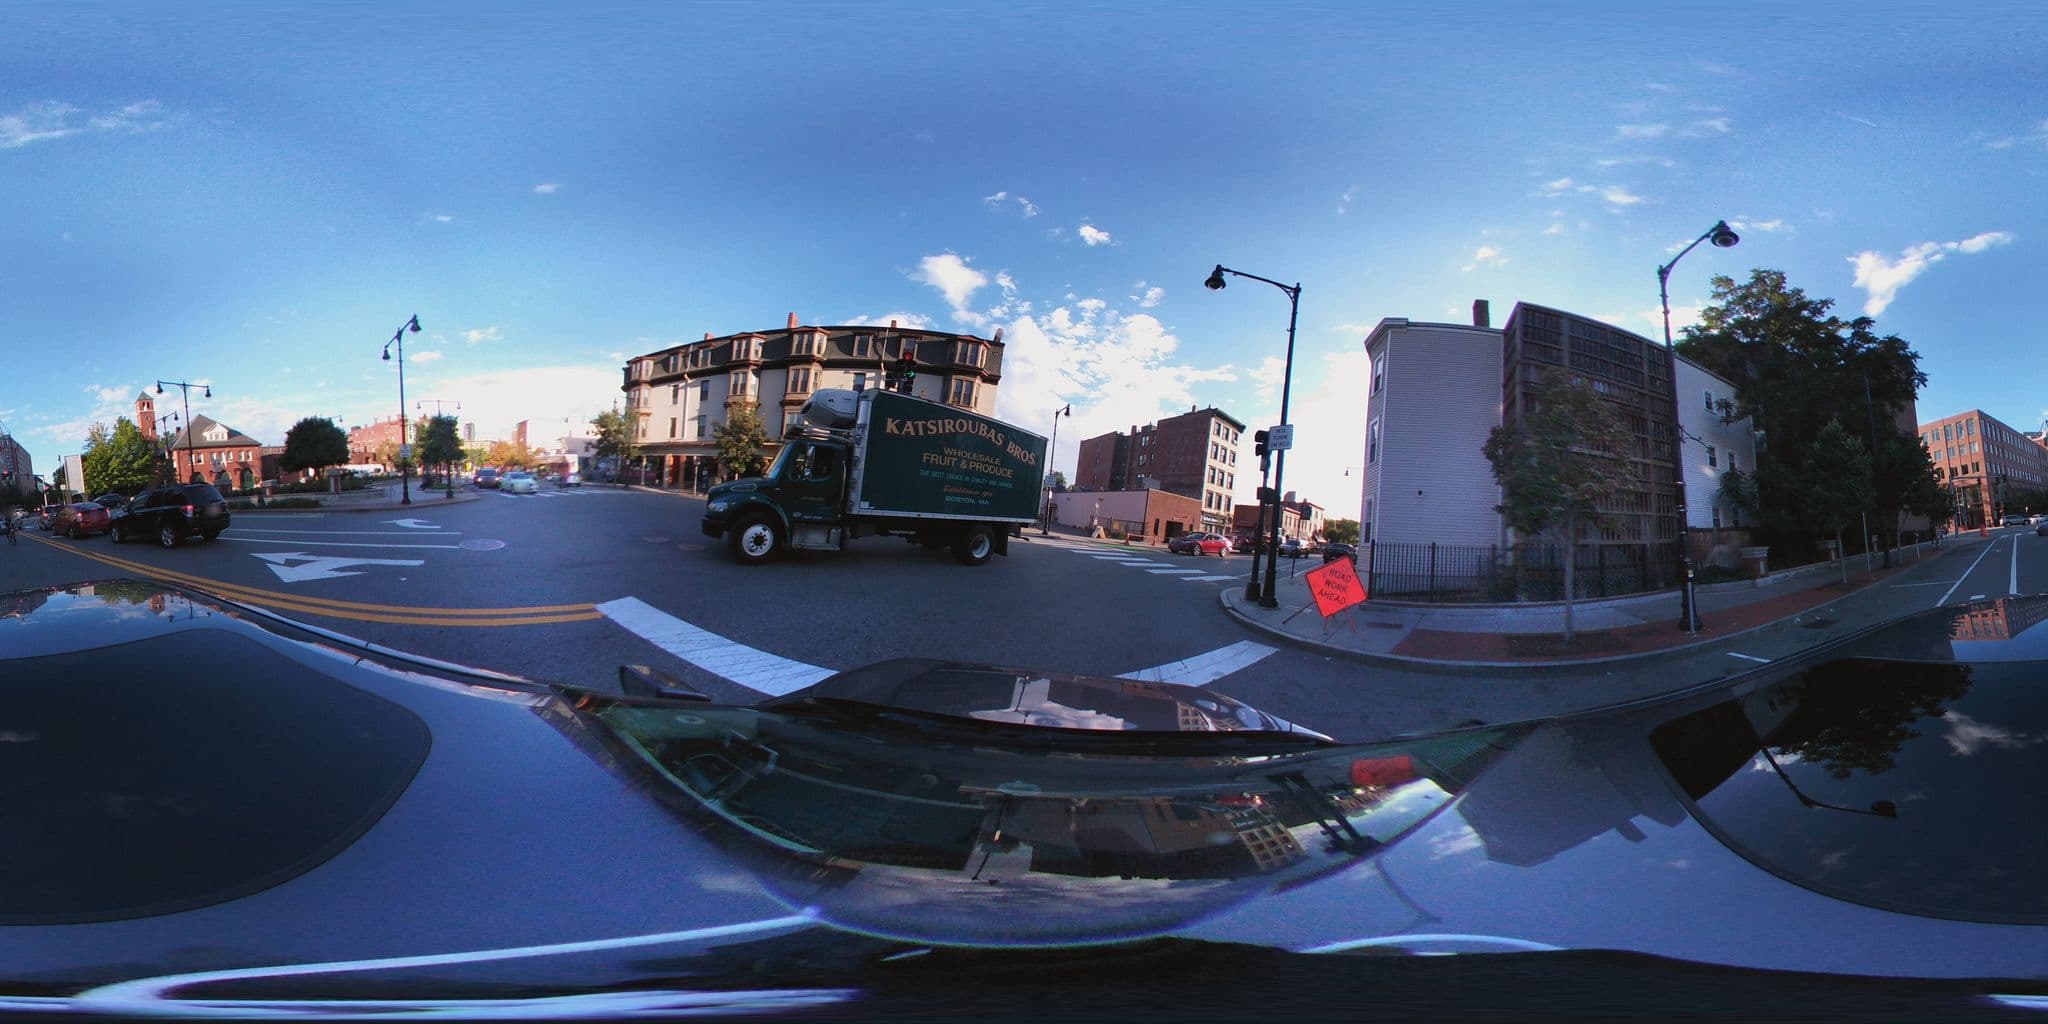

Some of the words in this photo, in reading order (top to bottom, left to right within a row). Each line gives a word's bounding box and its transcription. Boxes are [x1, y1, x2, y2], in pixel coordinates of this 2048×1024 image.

[886, 417, 1004, 446] KATSIROUBAS
[1007, 440, 1036, 465] BROS.
[944, 447, 1001, 465] WHOLESALE
[923, 453, 957, 467] FRUIT
[960, 459, 968, 469] &
[970, 461, 1013, 478] PRODUCE
[1328, 568, 1351, 582] ROAD
[1325, 579, 1348, 593] WORK
[1317, 588, 1346, 605] AHEAD
